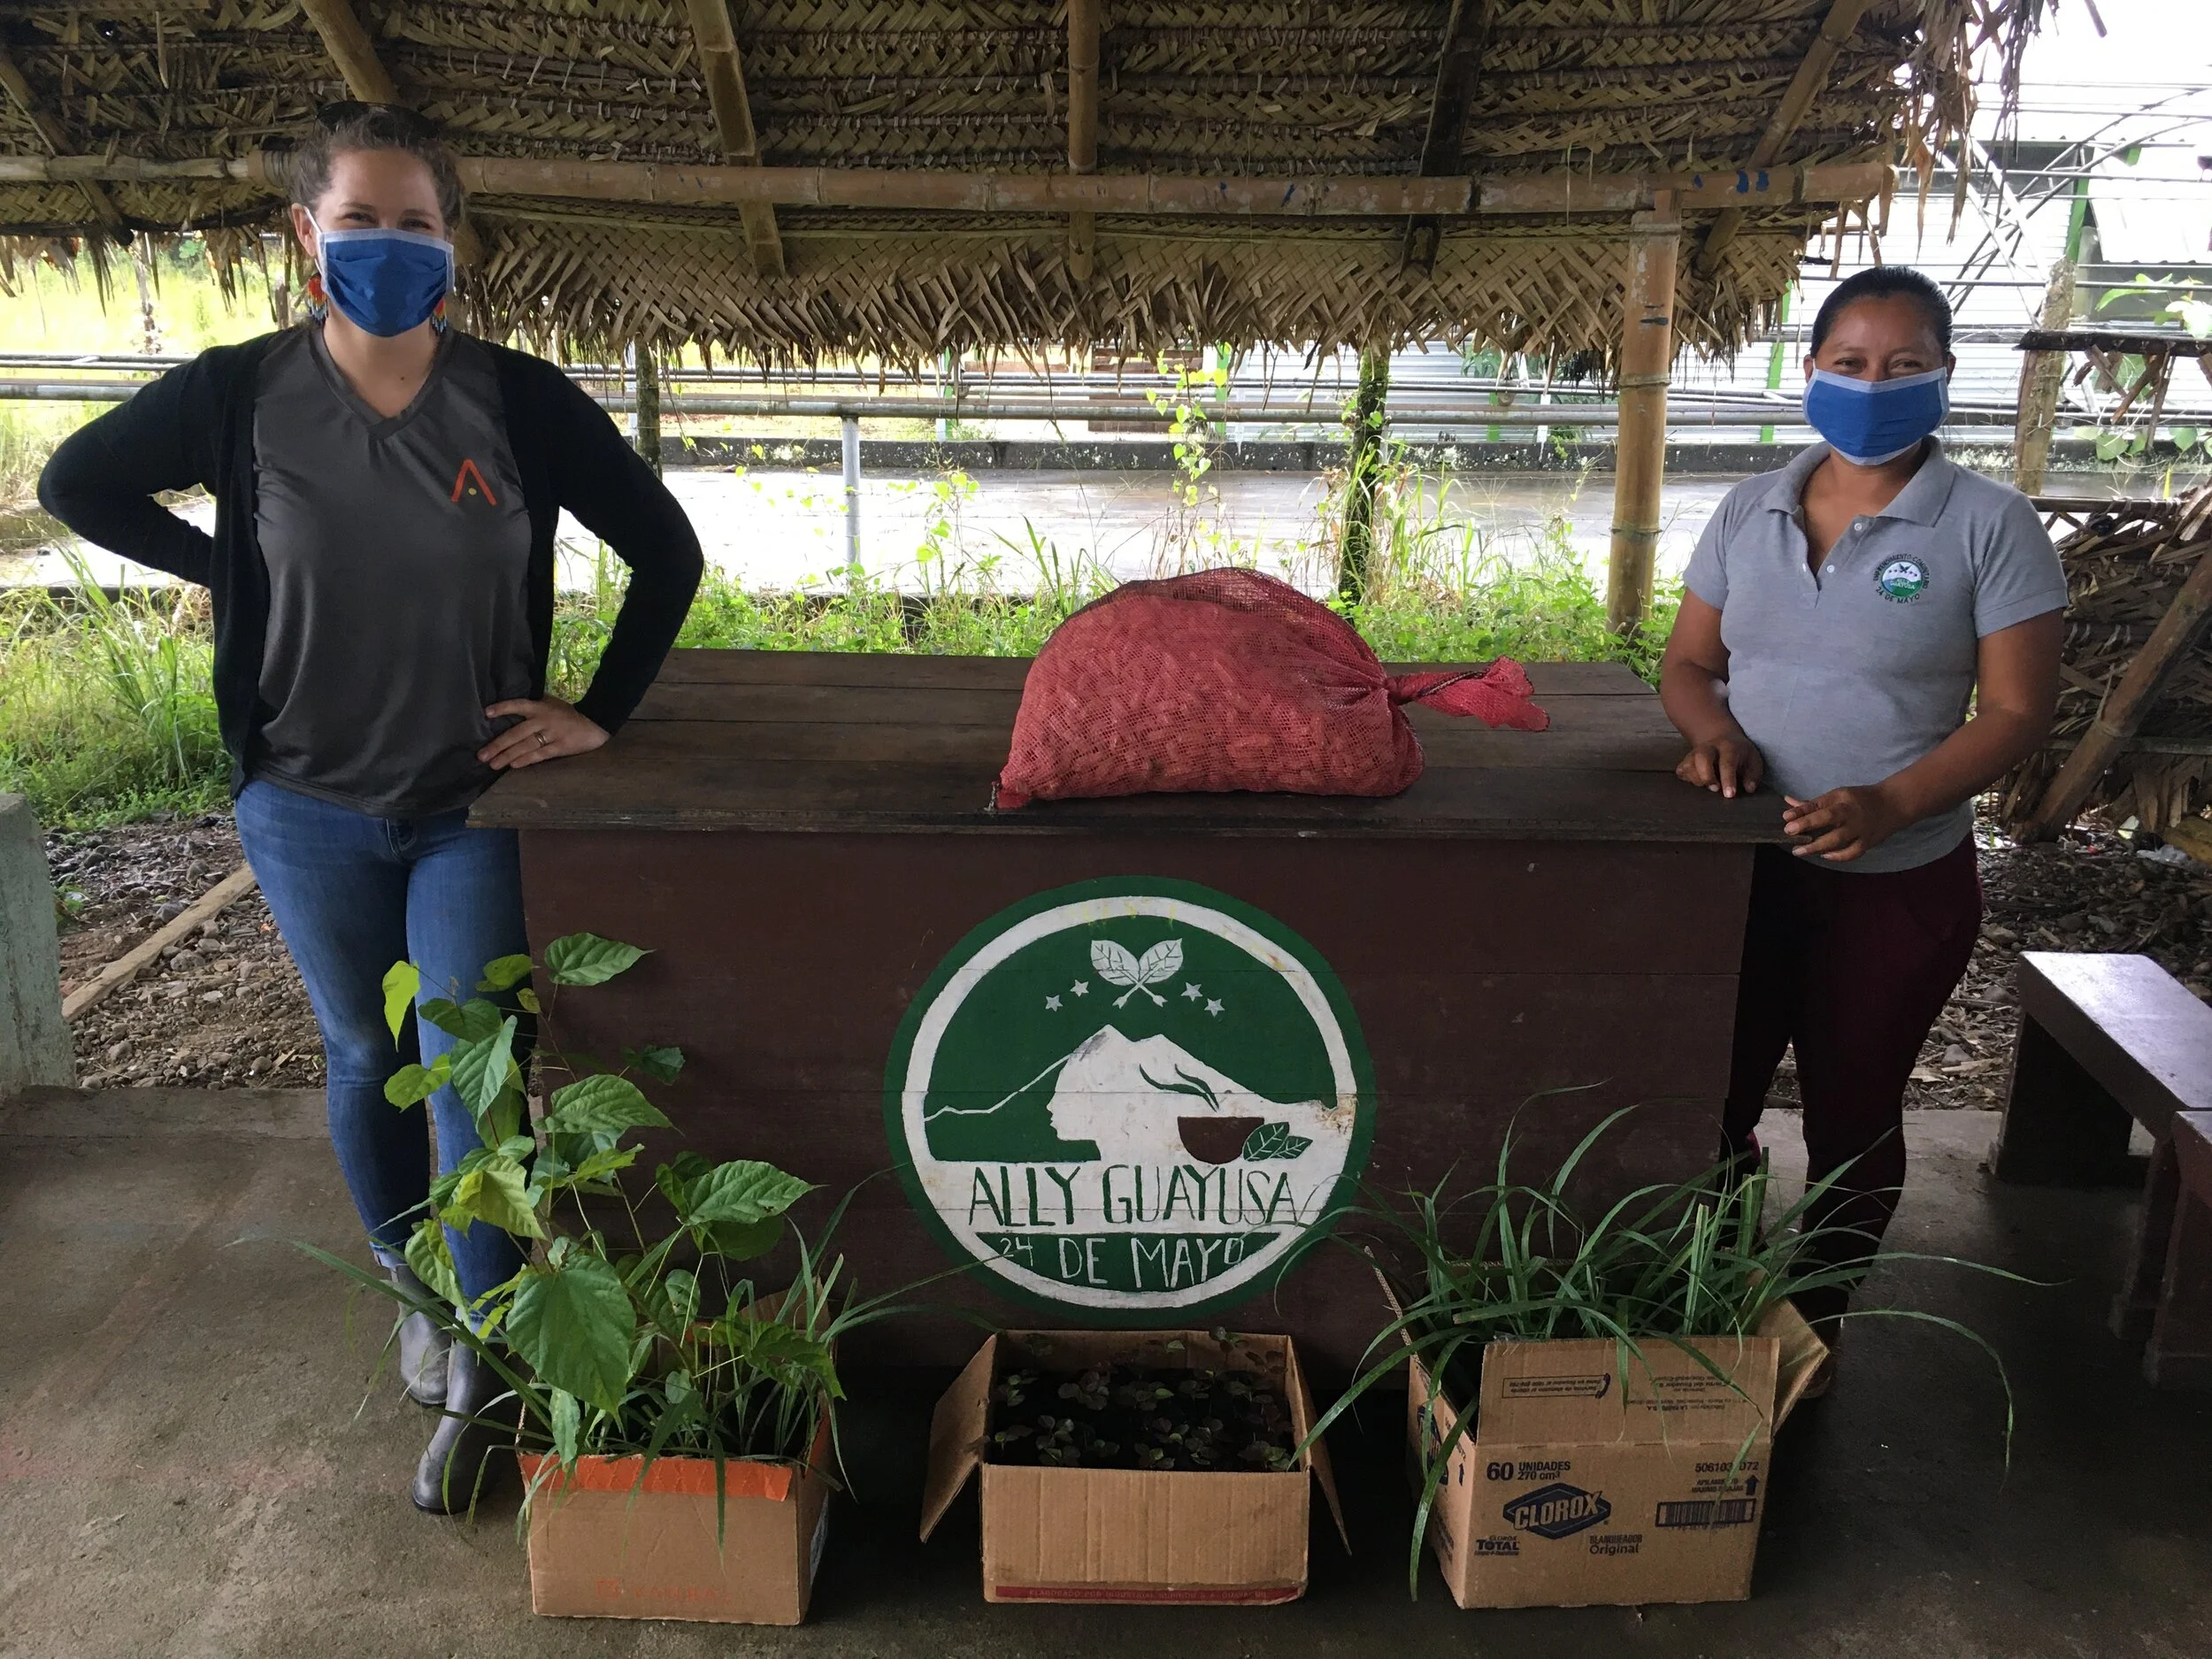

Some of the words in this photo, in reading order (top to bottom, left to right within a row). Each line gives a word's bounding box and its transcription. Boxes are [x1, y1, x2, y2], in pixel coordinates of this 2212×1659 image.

[1876, 586, 1885, 596] 24
[1897, 593, 1920, 604] MAYO
[969, 1164, 1081, 1227] ALLY
[1102, 1164, 1300, 1226] GUAYUSA
[1000, 1238, 1034, 1268] 24
[1058, 1237, 1108, 1285] DE
[1131, 1238, 1245, 1289] MAYO
[1486, 1462, 1514, 1480] 60
[1518, 1461, 1571, 1471] UNIDADES
[1695, 1461, 1759, 1473] 506103072
[1517, 1471, 1537, 1480] 270
[1513, 1491, 1603, 1531] CLOROX
[1476, 1540, 1520, 1550] TOTAL
[1589, 1534, 1642, 1544] BLANQUEADOR
[1589, 1543, 1639, 1556] Original
